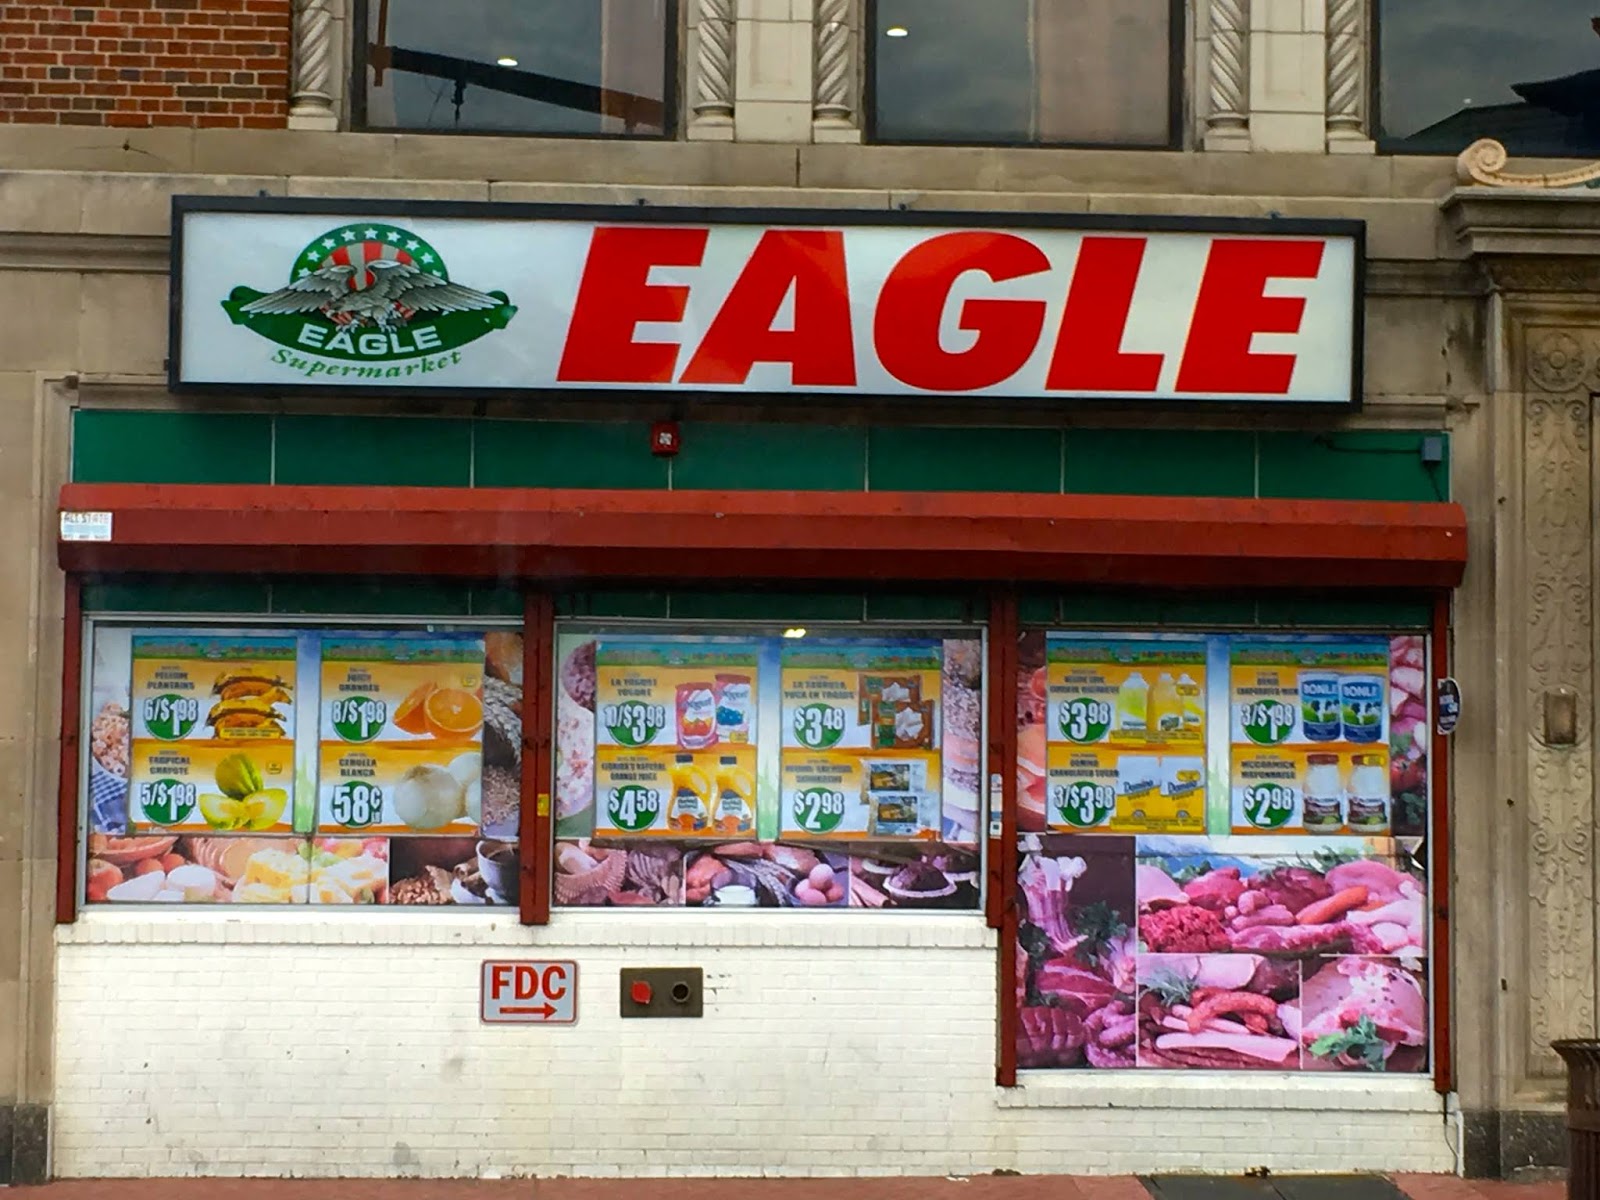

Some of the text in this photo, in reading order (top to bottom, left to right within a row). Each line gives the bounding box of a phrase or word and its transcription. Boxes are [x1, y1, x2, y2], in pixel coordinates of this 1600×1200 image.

[557, 226, 1325, 394] EAGLE
[297, 322, 442, 355] EAGLE
[271, 349, 462, 379] Supermarket
[491, 965, 566, 1000] FDC
